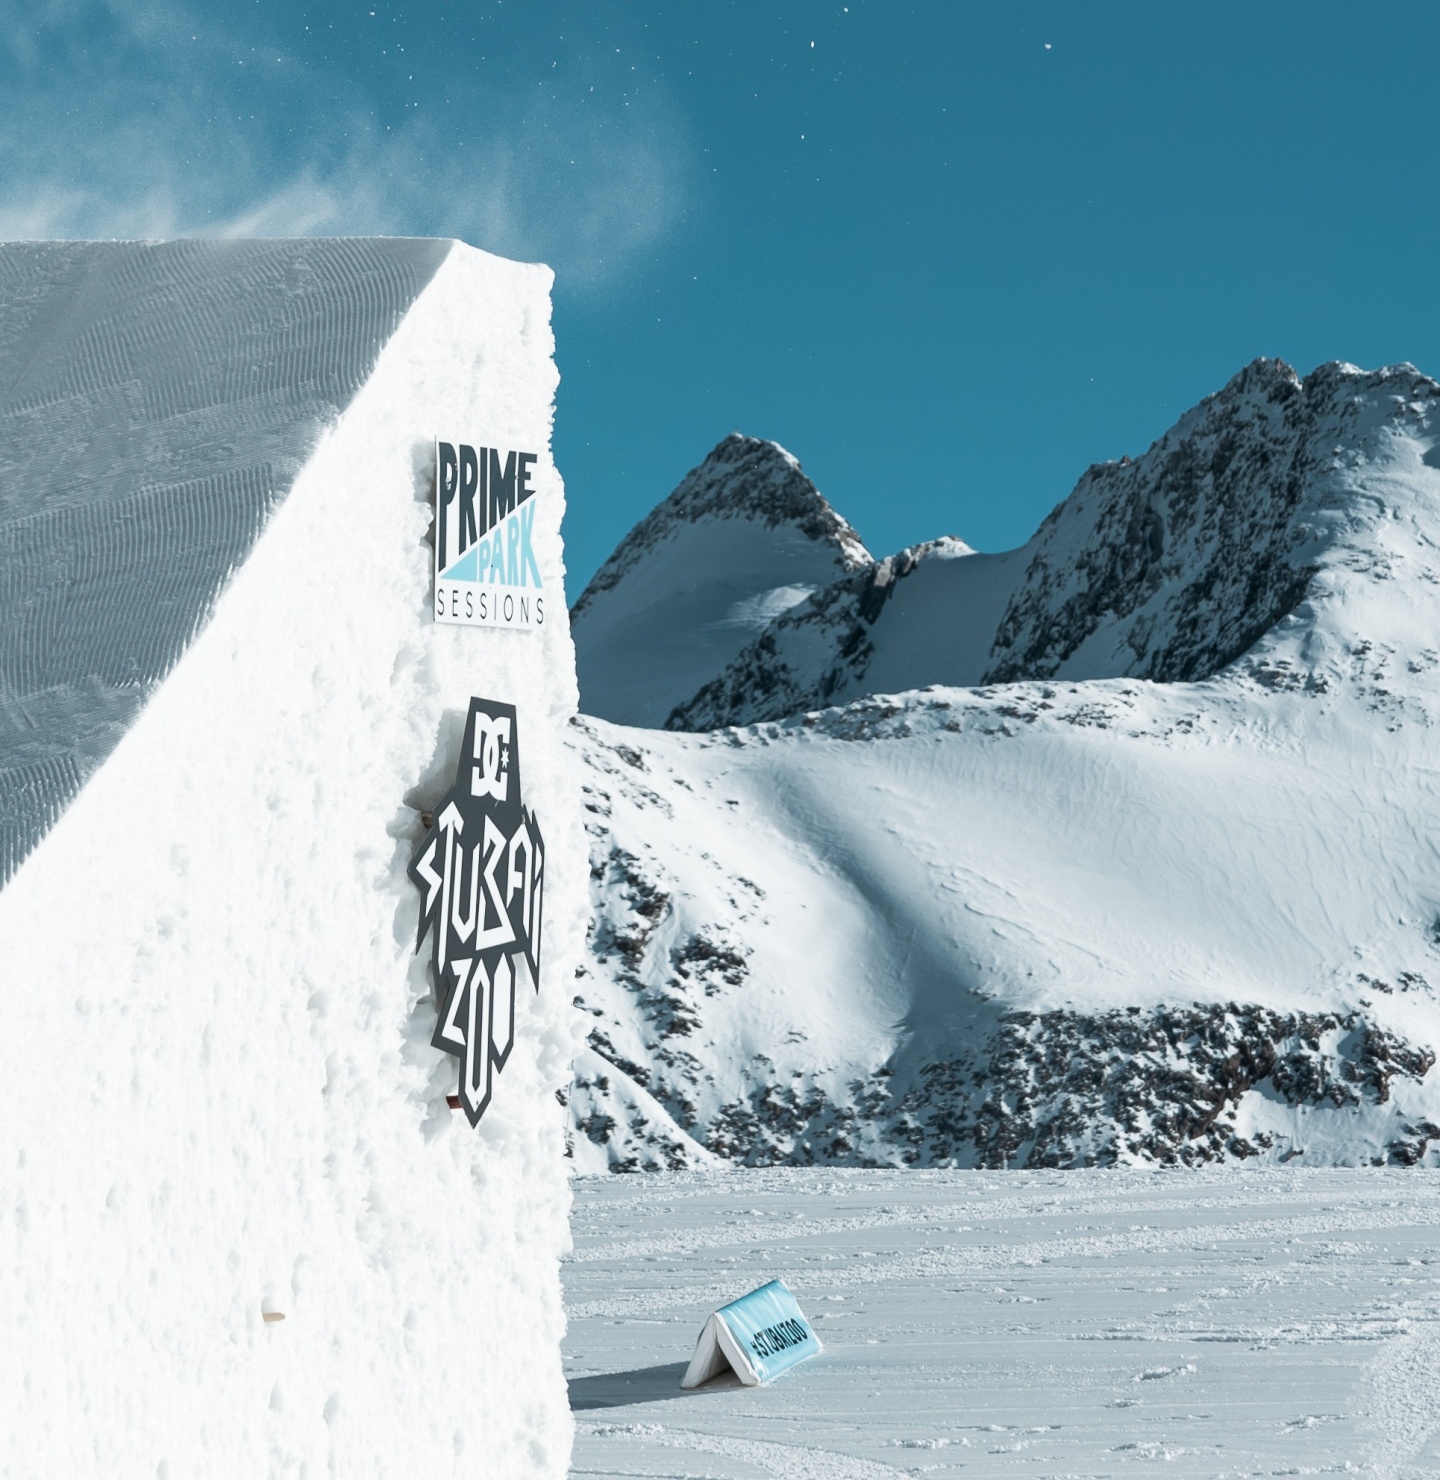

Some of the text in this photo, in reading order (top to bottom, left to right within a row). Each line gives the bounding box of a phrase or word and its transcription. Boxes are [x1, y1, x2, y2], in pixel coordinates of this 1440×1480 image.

[438, 441, 538, 573] PRIME
[478, 498, 543, 589] PARK
[437, 588, 544, 625] SESSIONS
[471, 711, 511, 801] DC
[415, 800, 542, 976] STUBAI
